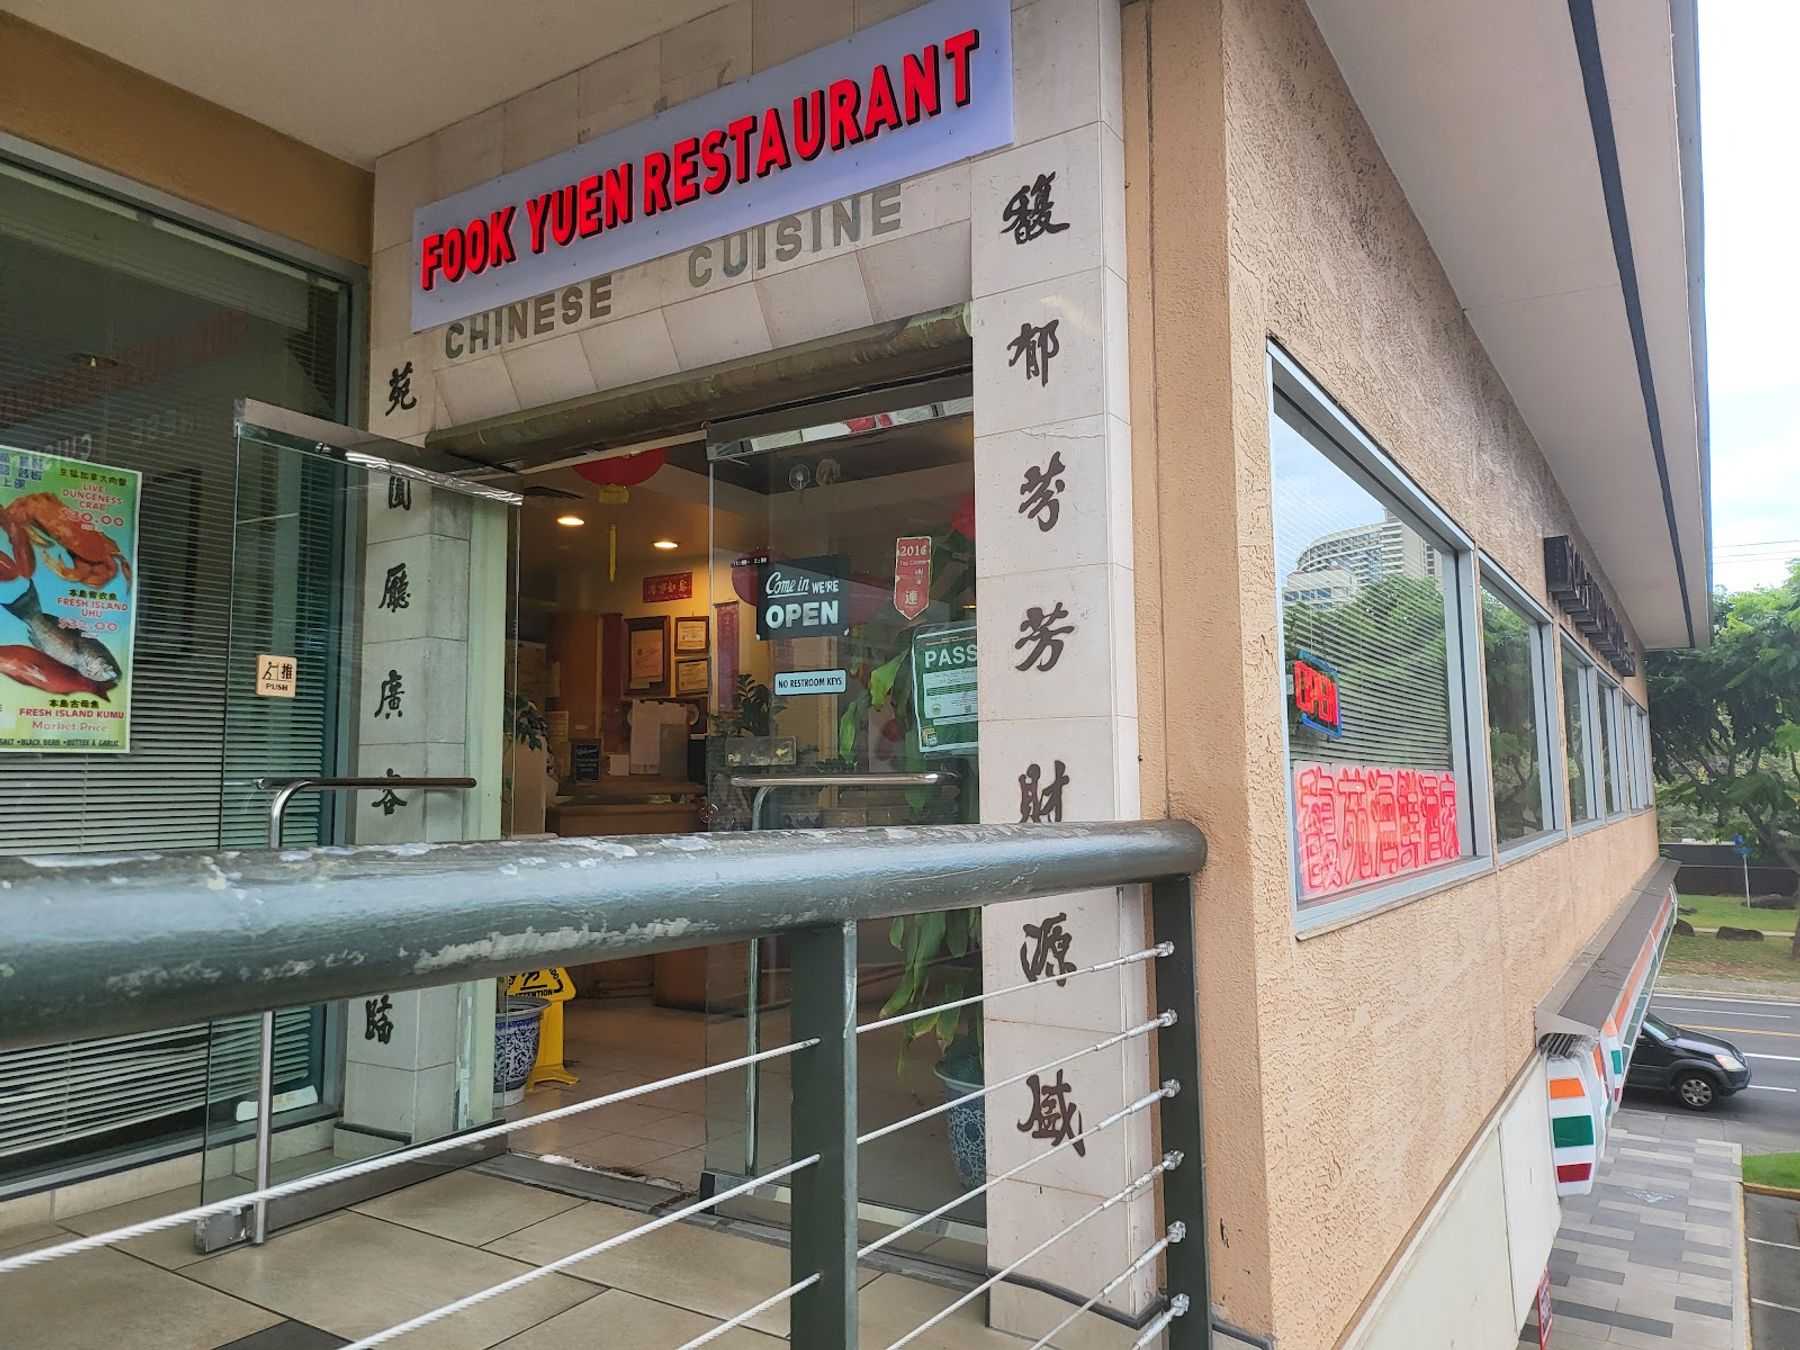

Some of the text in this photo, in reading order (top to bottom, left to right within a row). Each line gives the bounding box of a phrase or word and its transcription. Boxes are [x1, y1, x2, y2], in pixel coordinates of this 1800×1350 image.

[421, 29, 980, 291] FOOK YUEN RESTAURANT
[445, 185, 901, 359] CHINESE CUISINE
[83, 484, 105, 493] LIVE
[63, 489, 122, 504] DUNGENESS
[765, 571, 839, 594] Come in WE'RE
[57, 598, 128, 611] FRESH ISLAND
[81, 609, 103, 618] UHU
[765, 600, 839, 629] OPEN
[924, 643, 977, 669] PASS
[281, 662, 293, 680] 推
[265, 682, 289, 691] PUSH
[778, 677, 843, 689] NO RESTROOM KEYS
[1293, 660, 1339, 725] OPEN
[19, 707, 125, 719] FRESH ISLAND KUMU
[32, 720, 109, 732] Market Price
